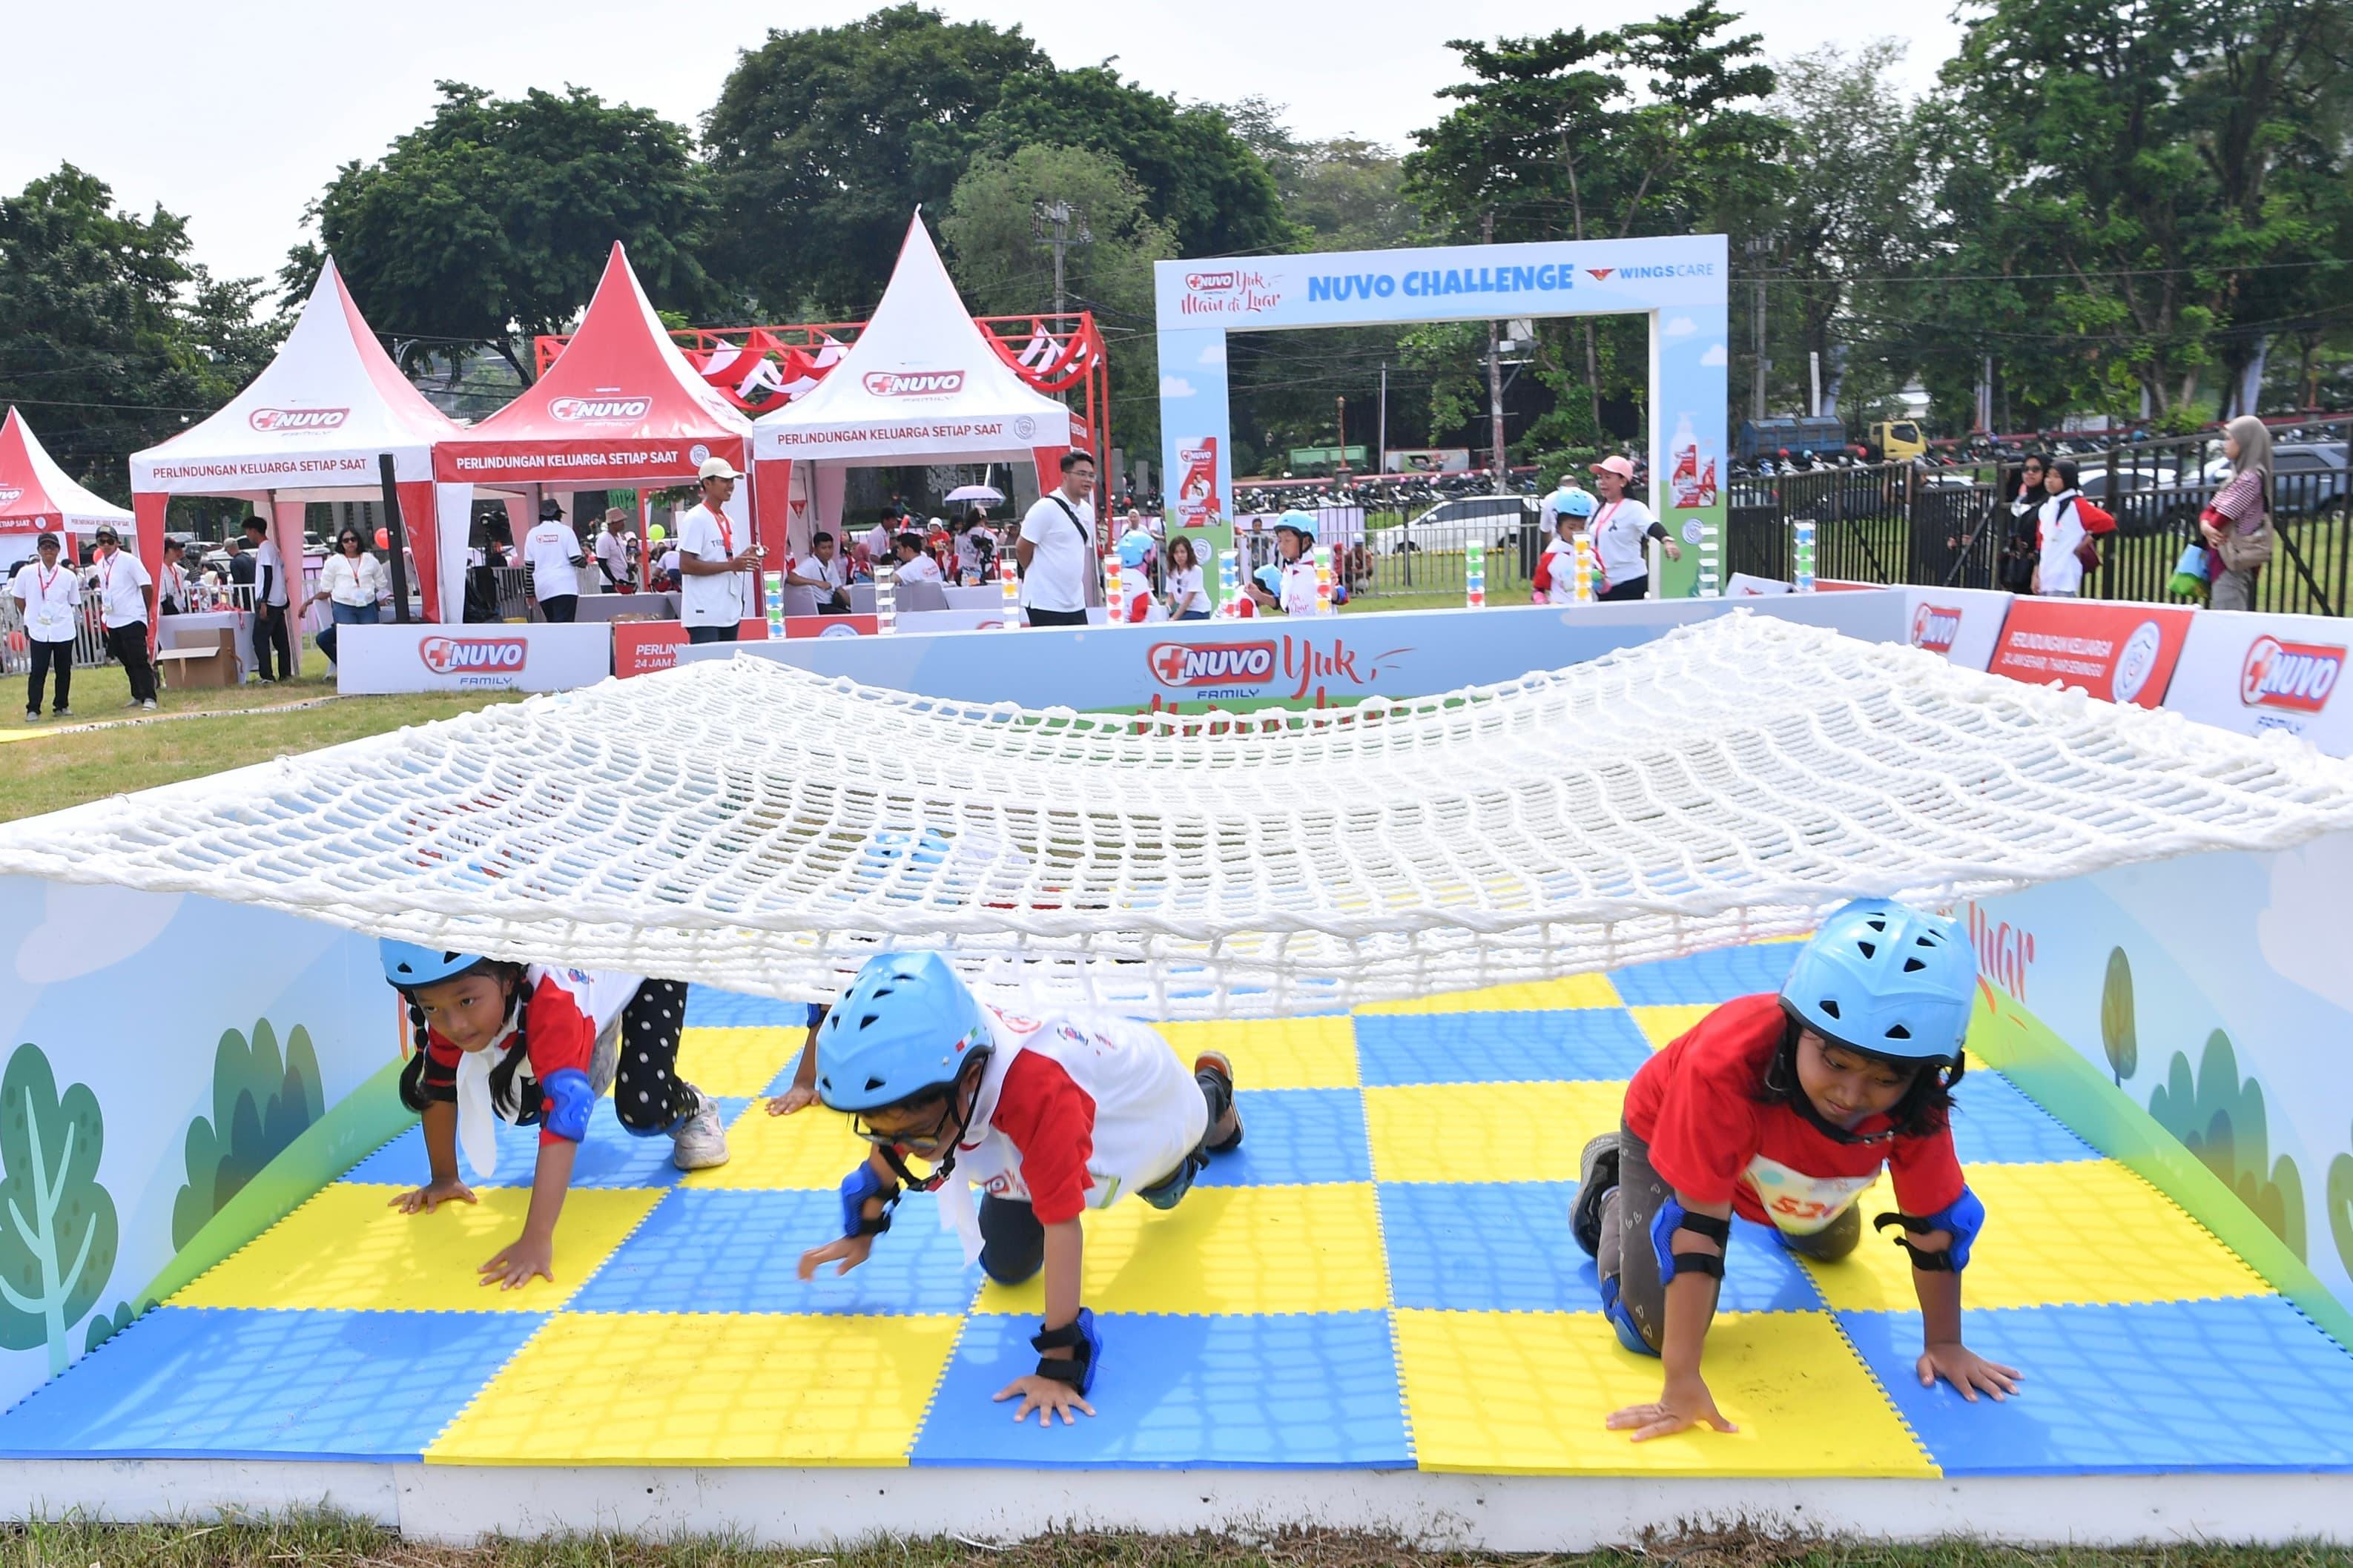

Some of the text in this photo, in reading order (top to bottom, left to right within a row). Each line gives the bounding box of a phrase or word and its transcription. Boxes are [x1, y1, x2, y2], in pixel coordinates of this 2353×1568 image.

[1200, 275, 1232, 287] NUVO
[1308, 264, 1574, 302] NUVO CHALLENGE
[1181, 289, 1281, 314] Main di Luar
[891, 374, 961, 392] NUVO
[274, 411, 345, 427] NUVO
[576, 402, 645, 417] NUVO
[777, 430, 867, 445] PERLINDUNGAN
[871, 426, 930, 442] KELUARGA
[933, 424, 971, 437] SETIAP
[974, 423, 1003, 435] SAAT
[153, 458, 367, 479] PERLINDUNGAN KELUARGA SETIAP SAAT
[456, 455, 544, 470] PERLINDUNGAN
[547, 453, 606, 467] KELUARGA
[608, 451, 647, 466] SETIAP
[650, 450, 679, 464] SAAT
[449, 643, 523, 666] NUVO
[634, 658, 647, 668] 24
[648, 658, 672, 667] JAM
[1184, 649, 1271, 678] NUVO
[460, 676, 513, 686] FAMILY
[2260, 652, 2340, 702] NUVO
[1197, 688, 1260, 700] FAMILY
